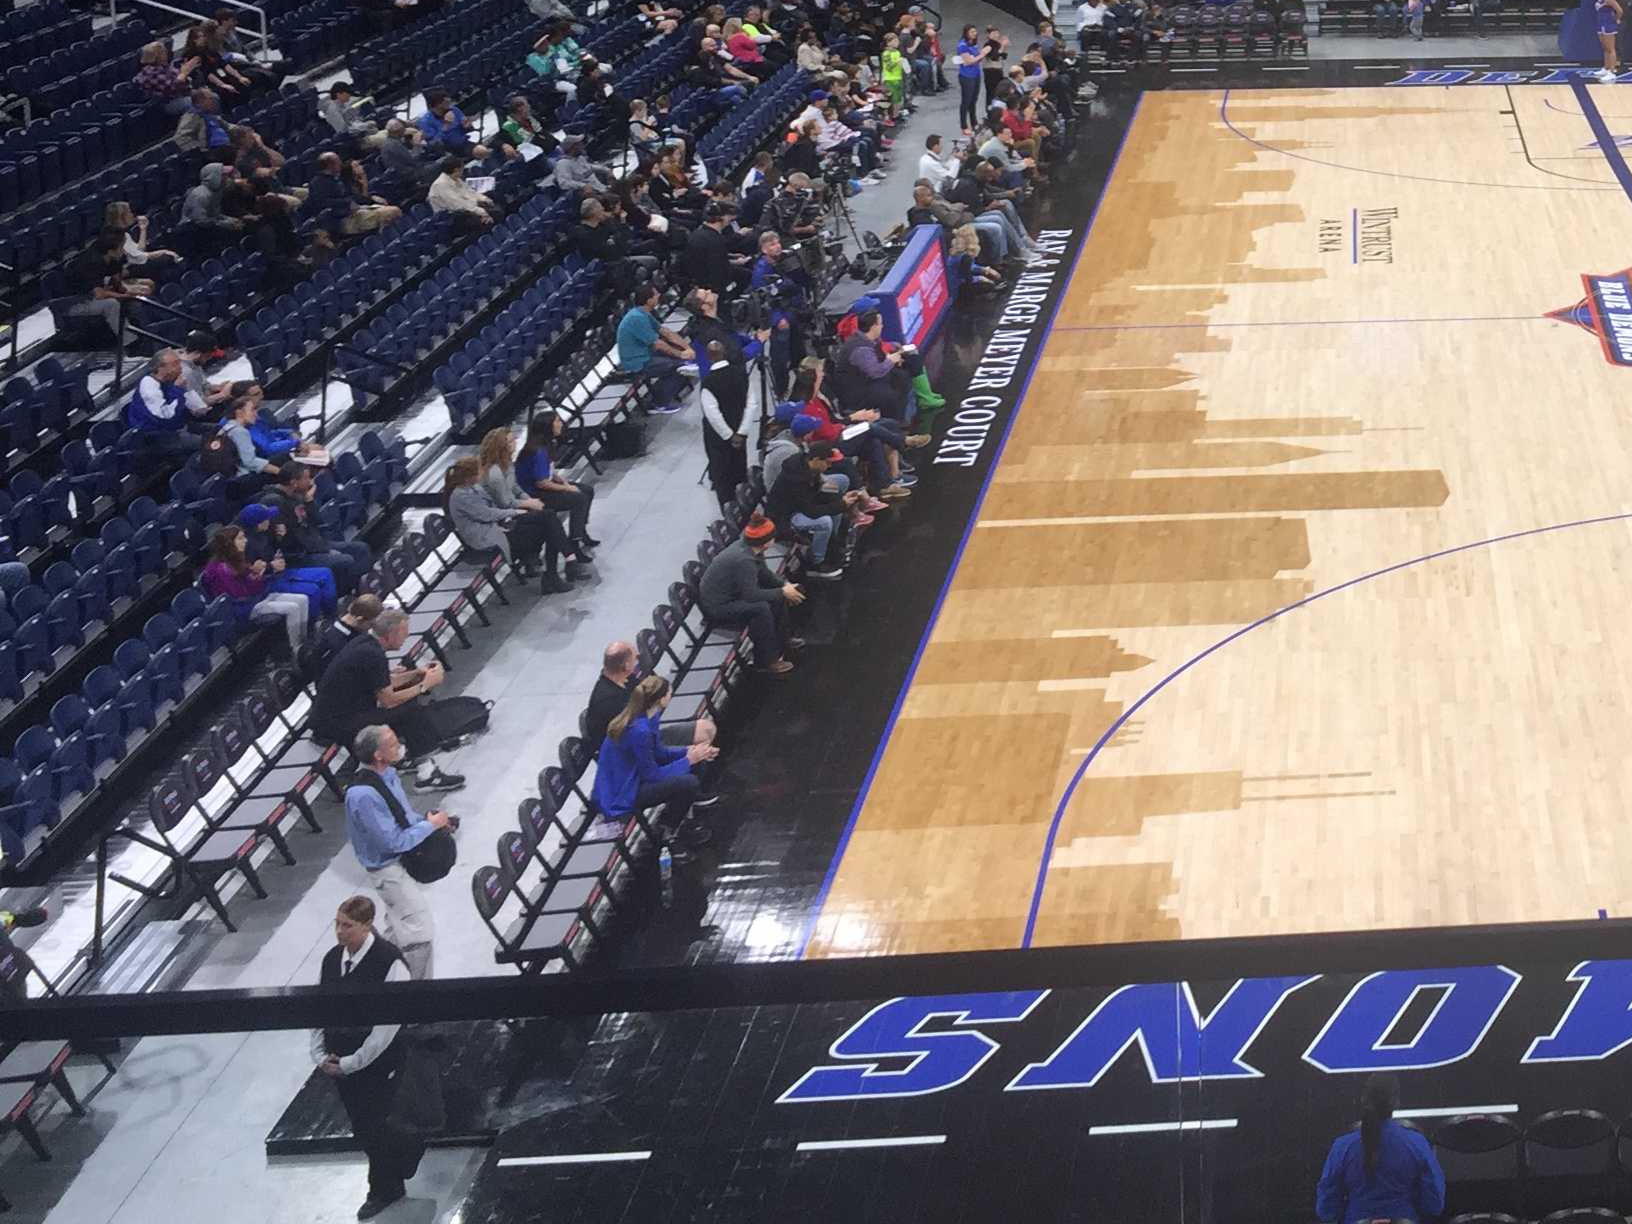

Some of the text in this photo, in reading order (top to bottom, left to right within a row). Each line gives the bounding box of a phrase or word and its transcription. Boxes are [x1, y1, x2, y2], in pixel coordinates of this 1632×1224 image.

[1318, 218, 1343, 253] ARENA
[1360, 207, 1399, 264] WINTRUST
[997, 271, 1056, 325] MARGE
[1597, 280, 1624, 312] BLUE
[967, 328, 1032, 391] MEYER
[933, 395, 1002, 467] COURT
